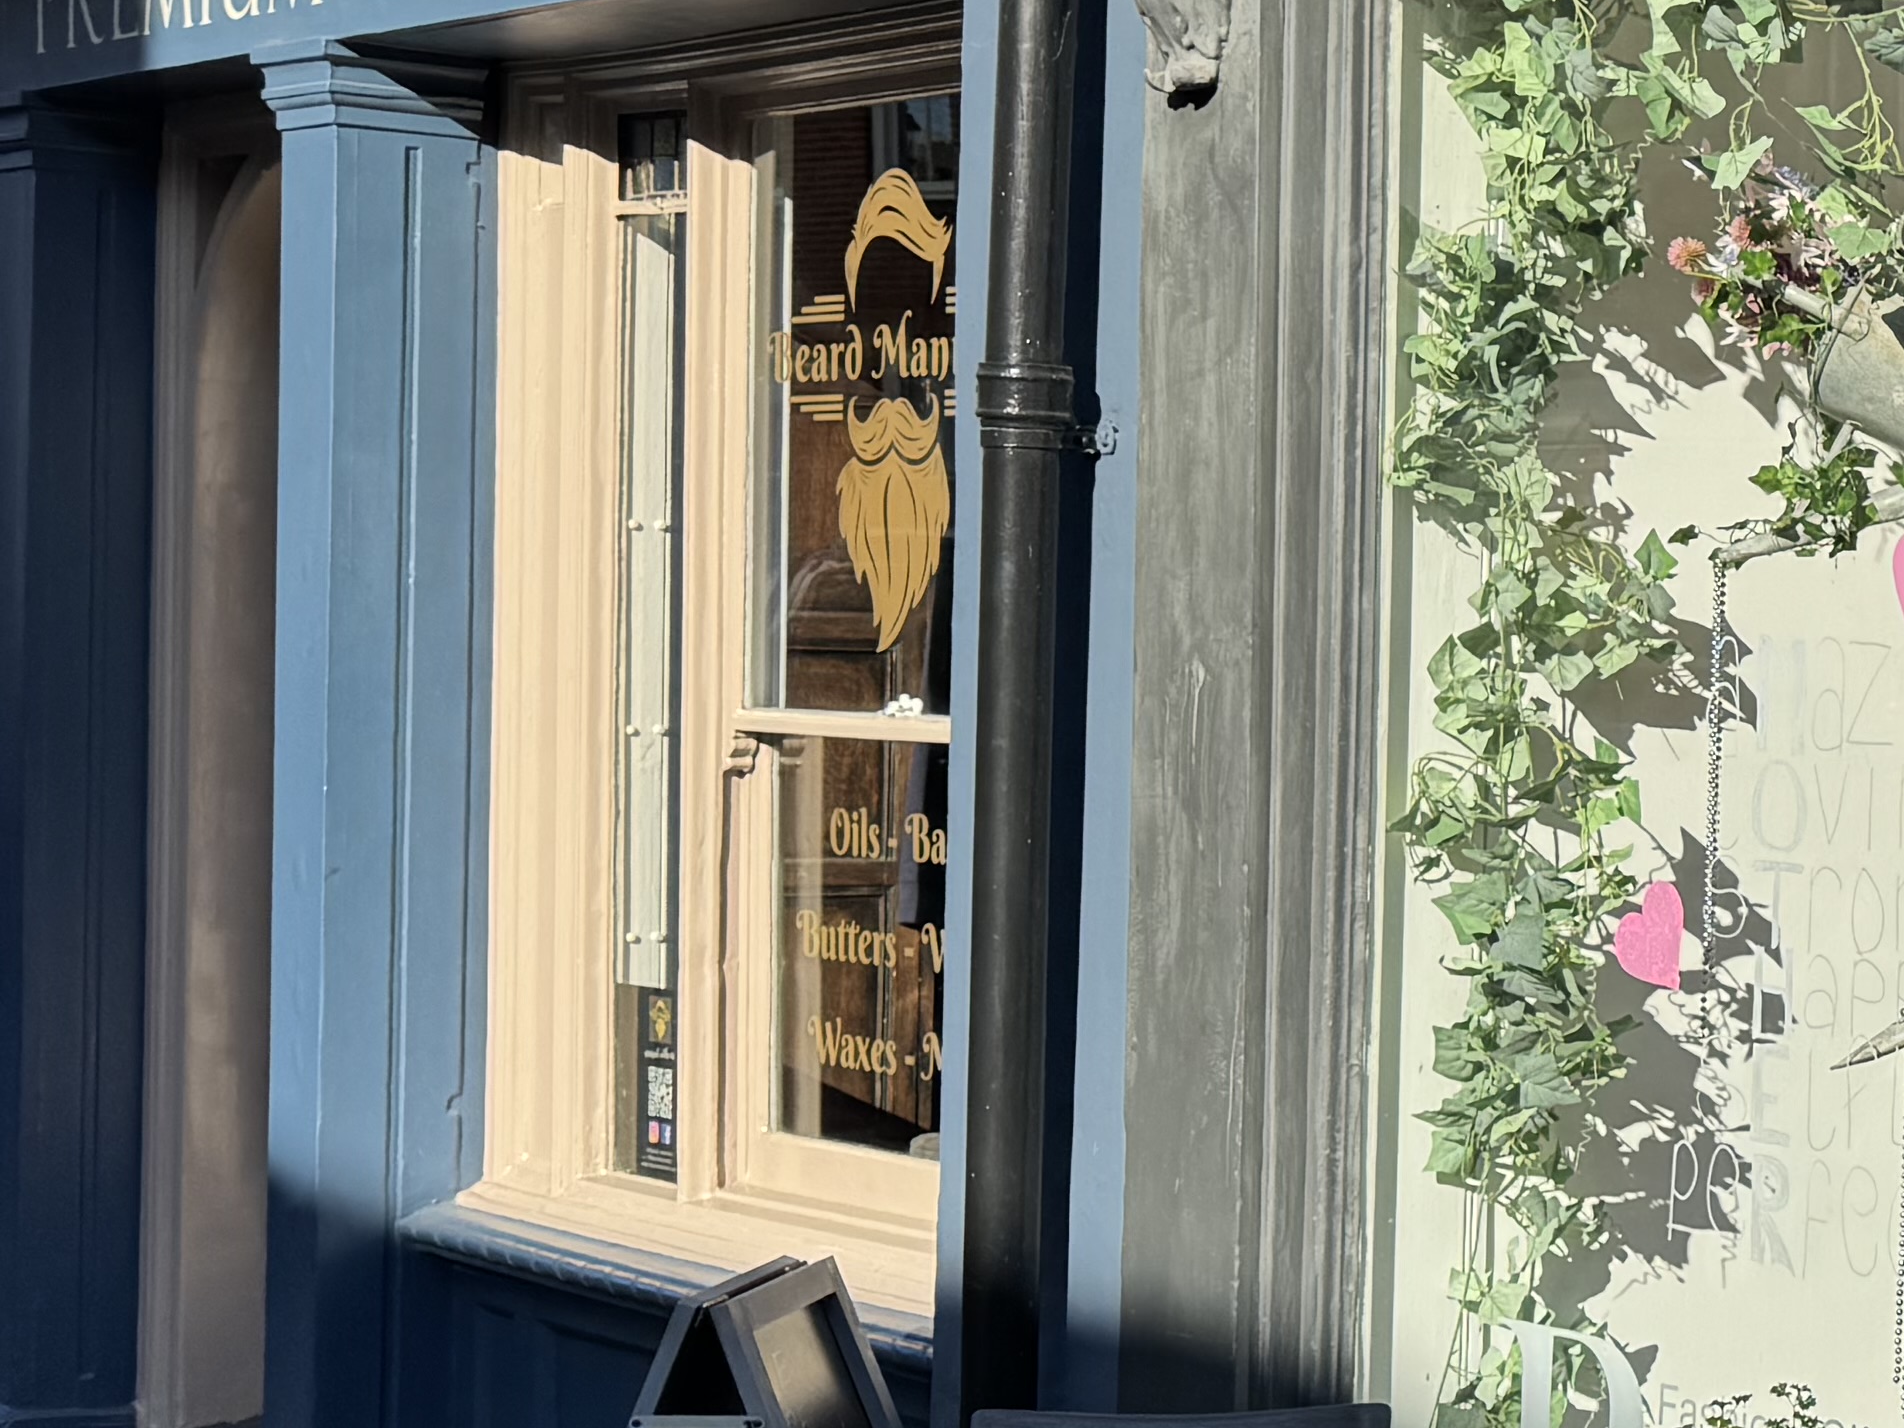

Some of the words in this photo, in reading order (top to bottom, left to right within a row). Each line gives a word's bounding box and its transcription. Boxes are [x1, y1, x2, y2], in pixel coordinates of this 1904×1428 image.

[768, 324, 863, 383] Beard
[872, 309, 956, 383] Man
[830, 807, 880, 859] Oils
[796, 909, 897, 968] Butters
[807, 1016, 897, 1076] Waxes
